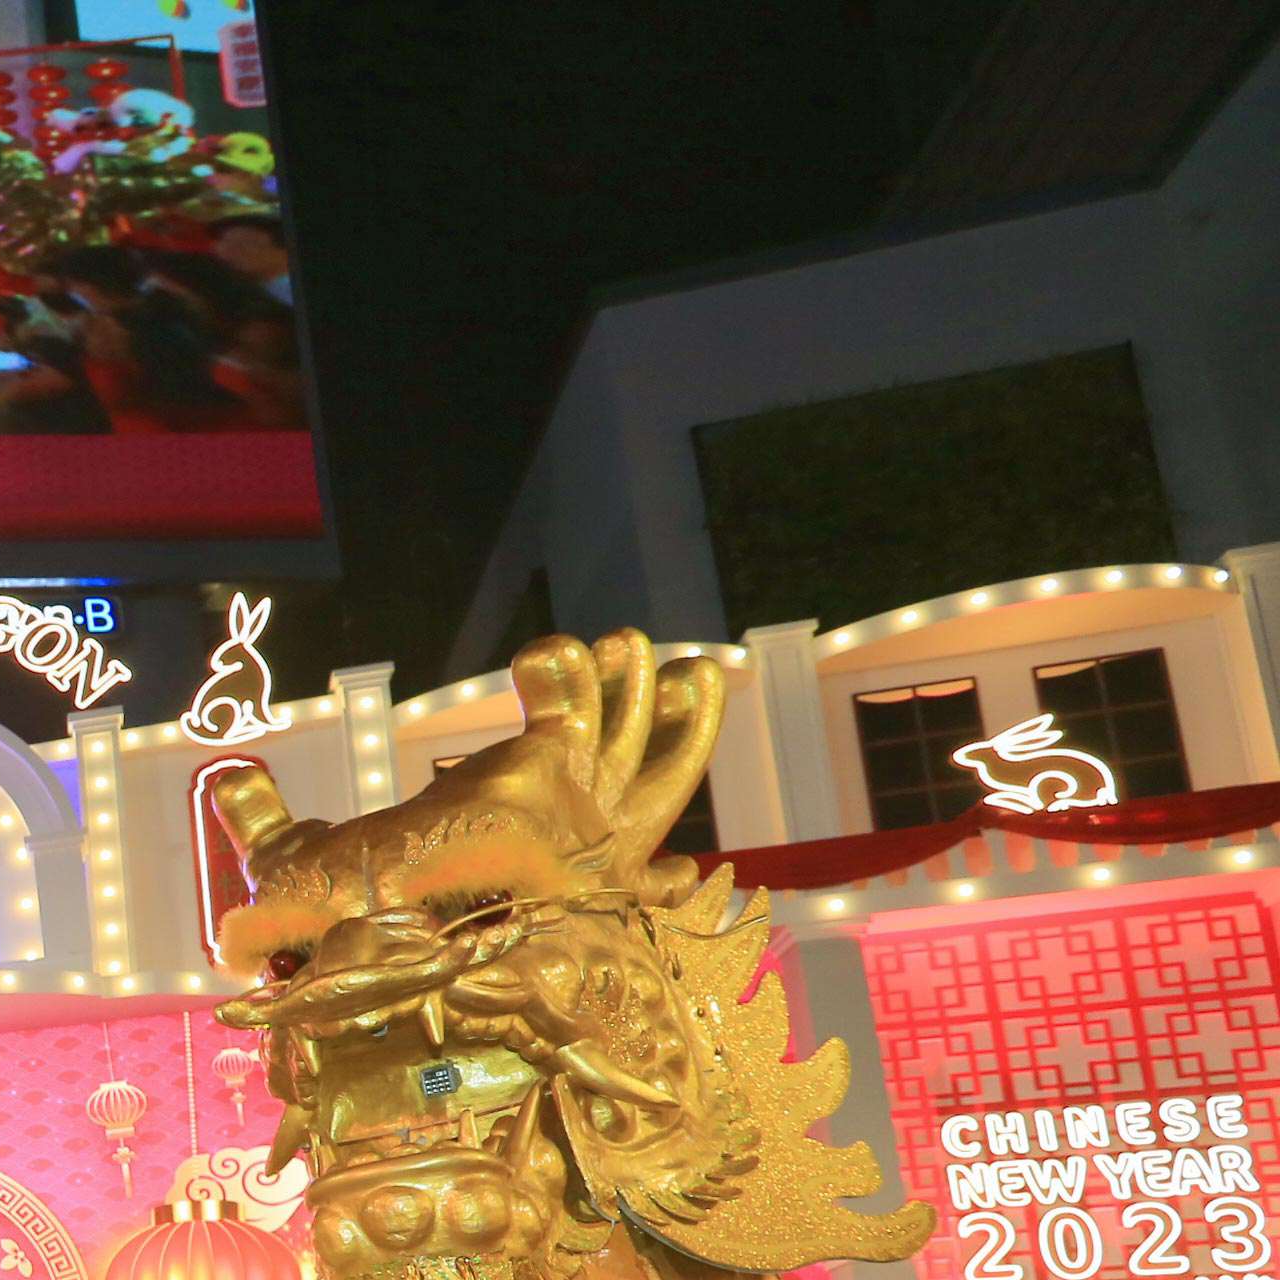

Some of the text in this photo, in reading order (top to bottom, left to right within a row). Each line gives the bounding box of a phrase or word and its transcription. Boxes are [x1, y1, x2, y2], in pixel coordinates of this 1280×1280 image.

[940, 1094, 1250, 1159] CHINESE
[946, 1144, 1261, 1211] NEW YEAR
